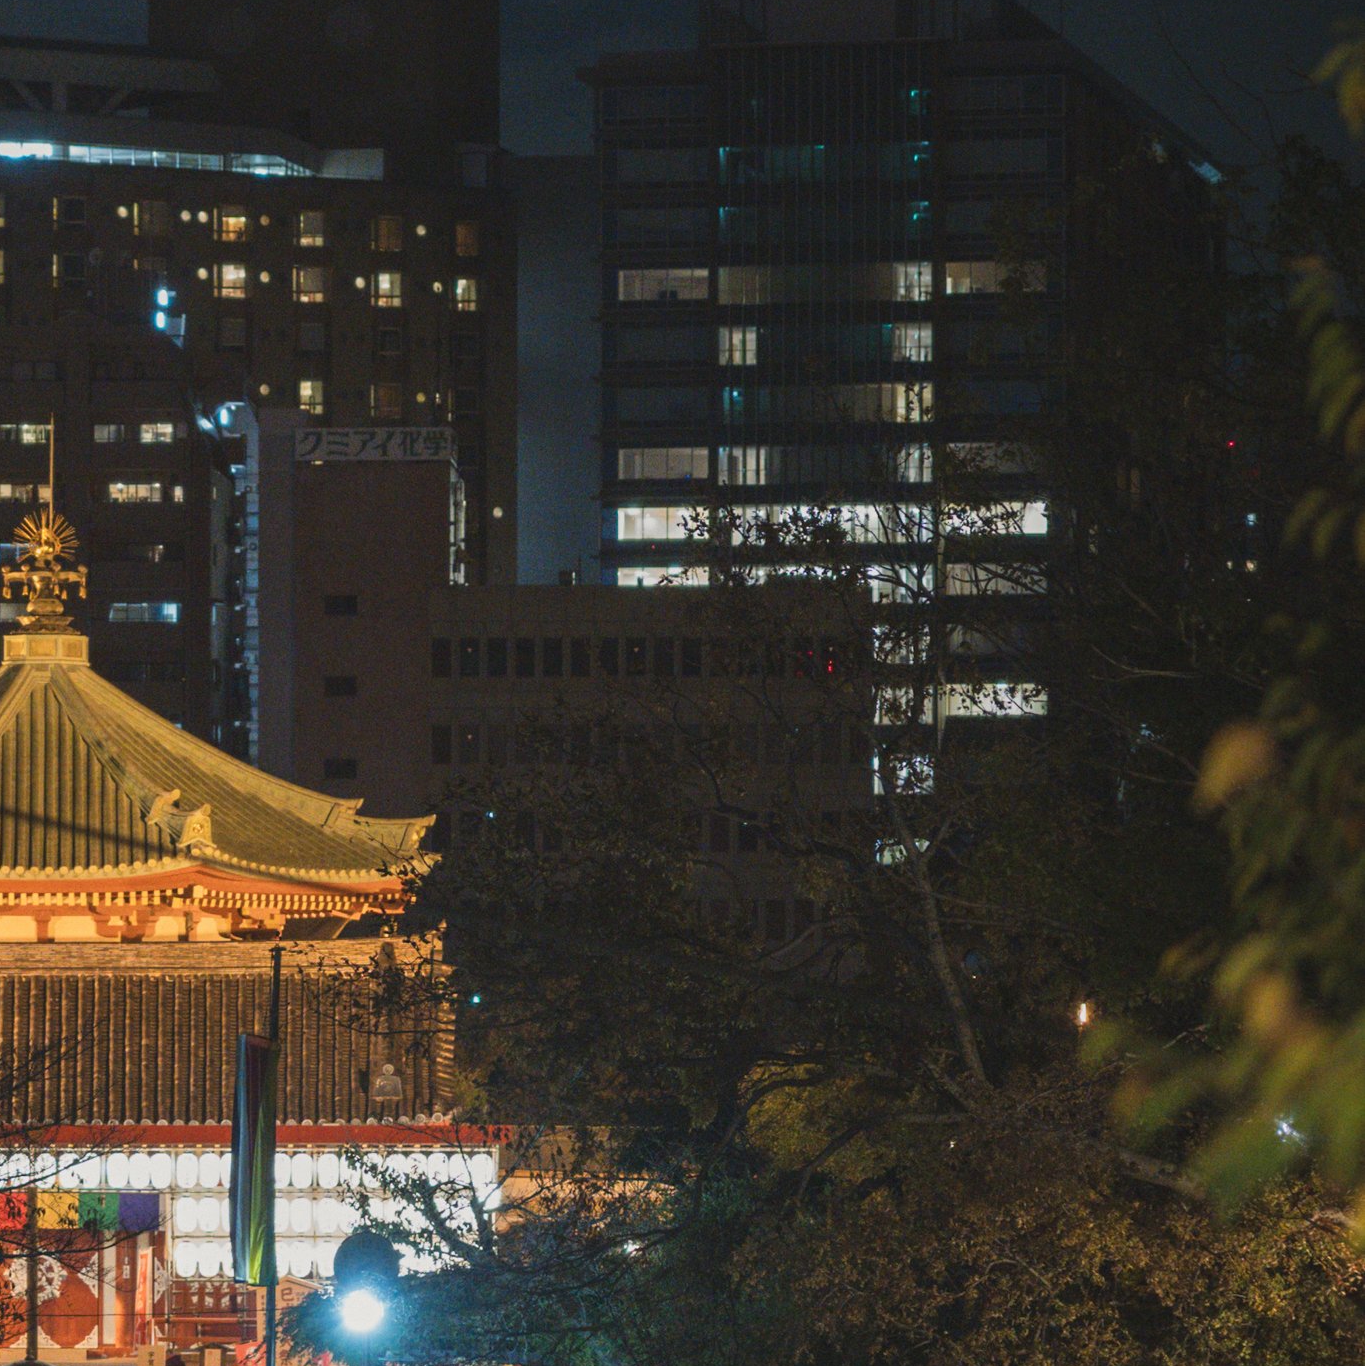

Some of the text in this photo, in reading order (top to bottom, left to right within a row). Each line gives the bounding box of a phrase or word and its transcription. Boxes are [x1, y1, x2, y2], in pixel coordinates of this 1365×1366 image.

[298, 429, 449, 458] クミアイ化学
